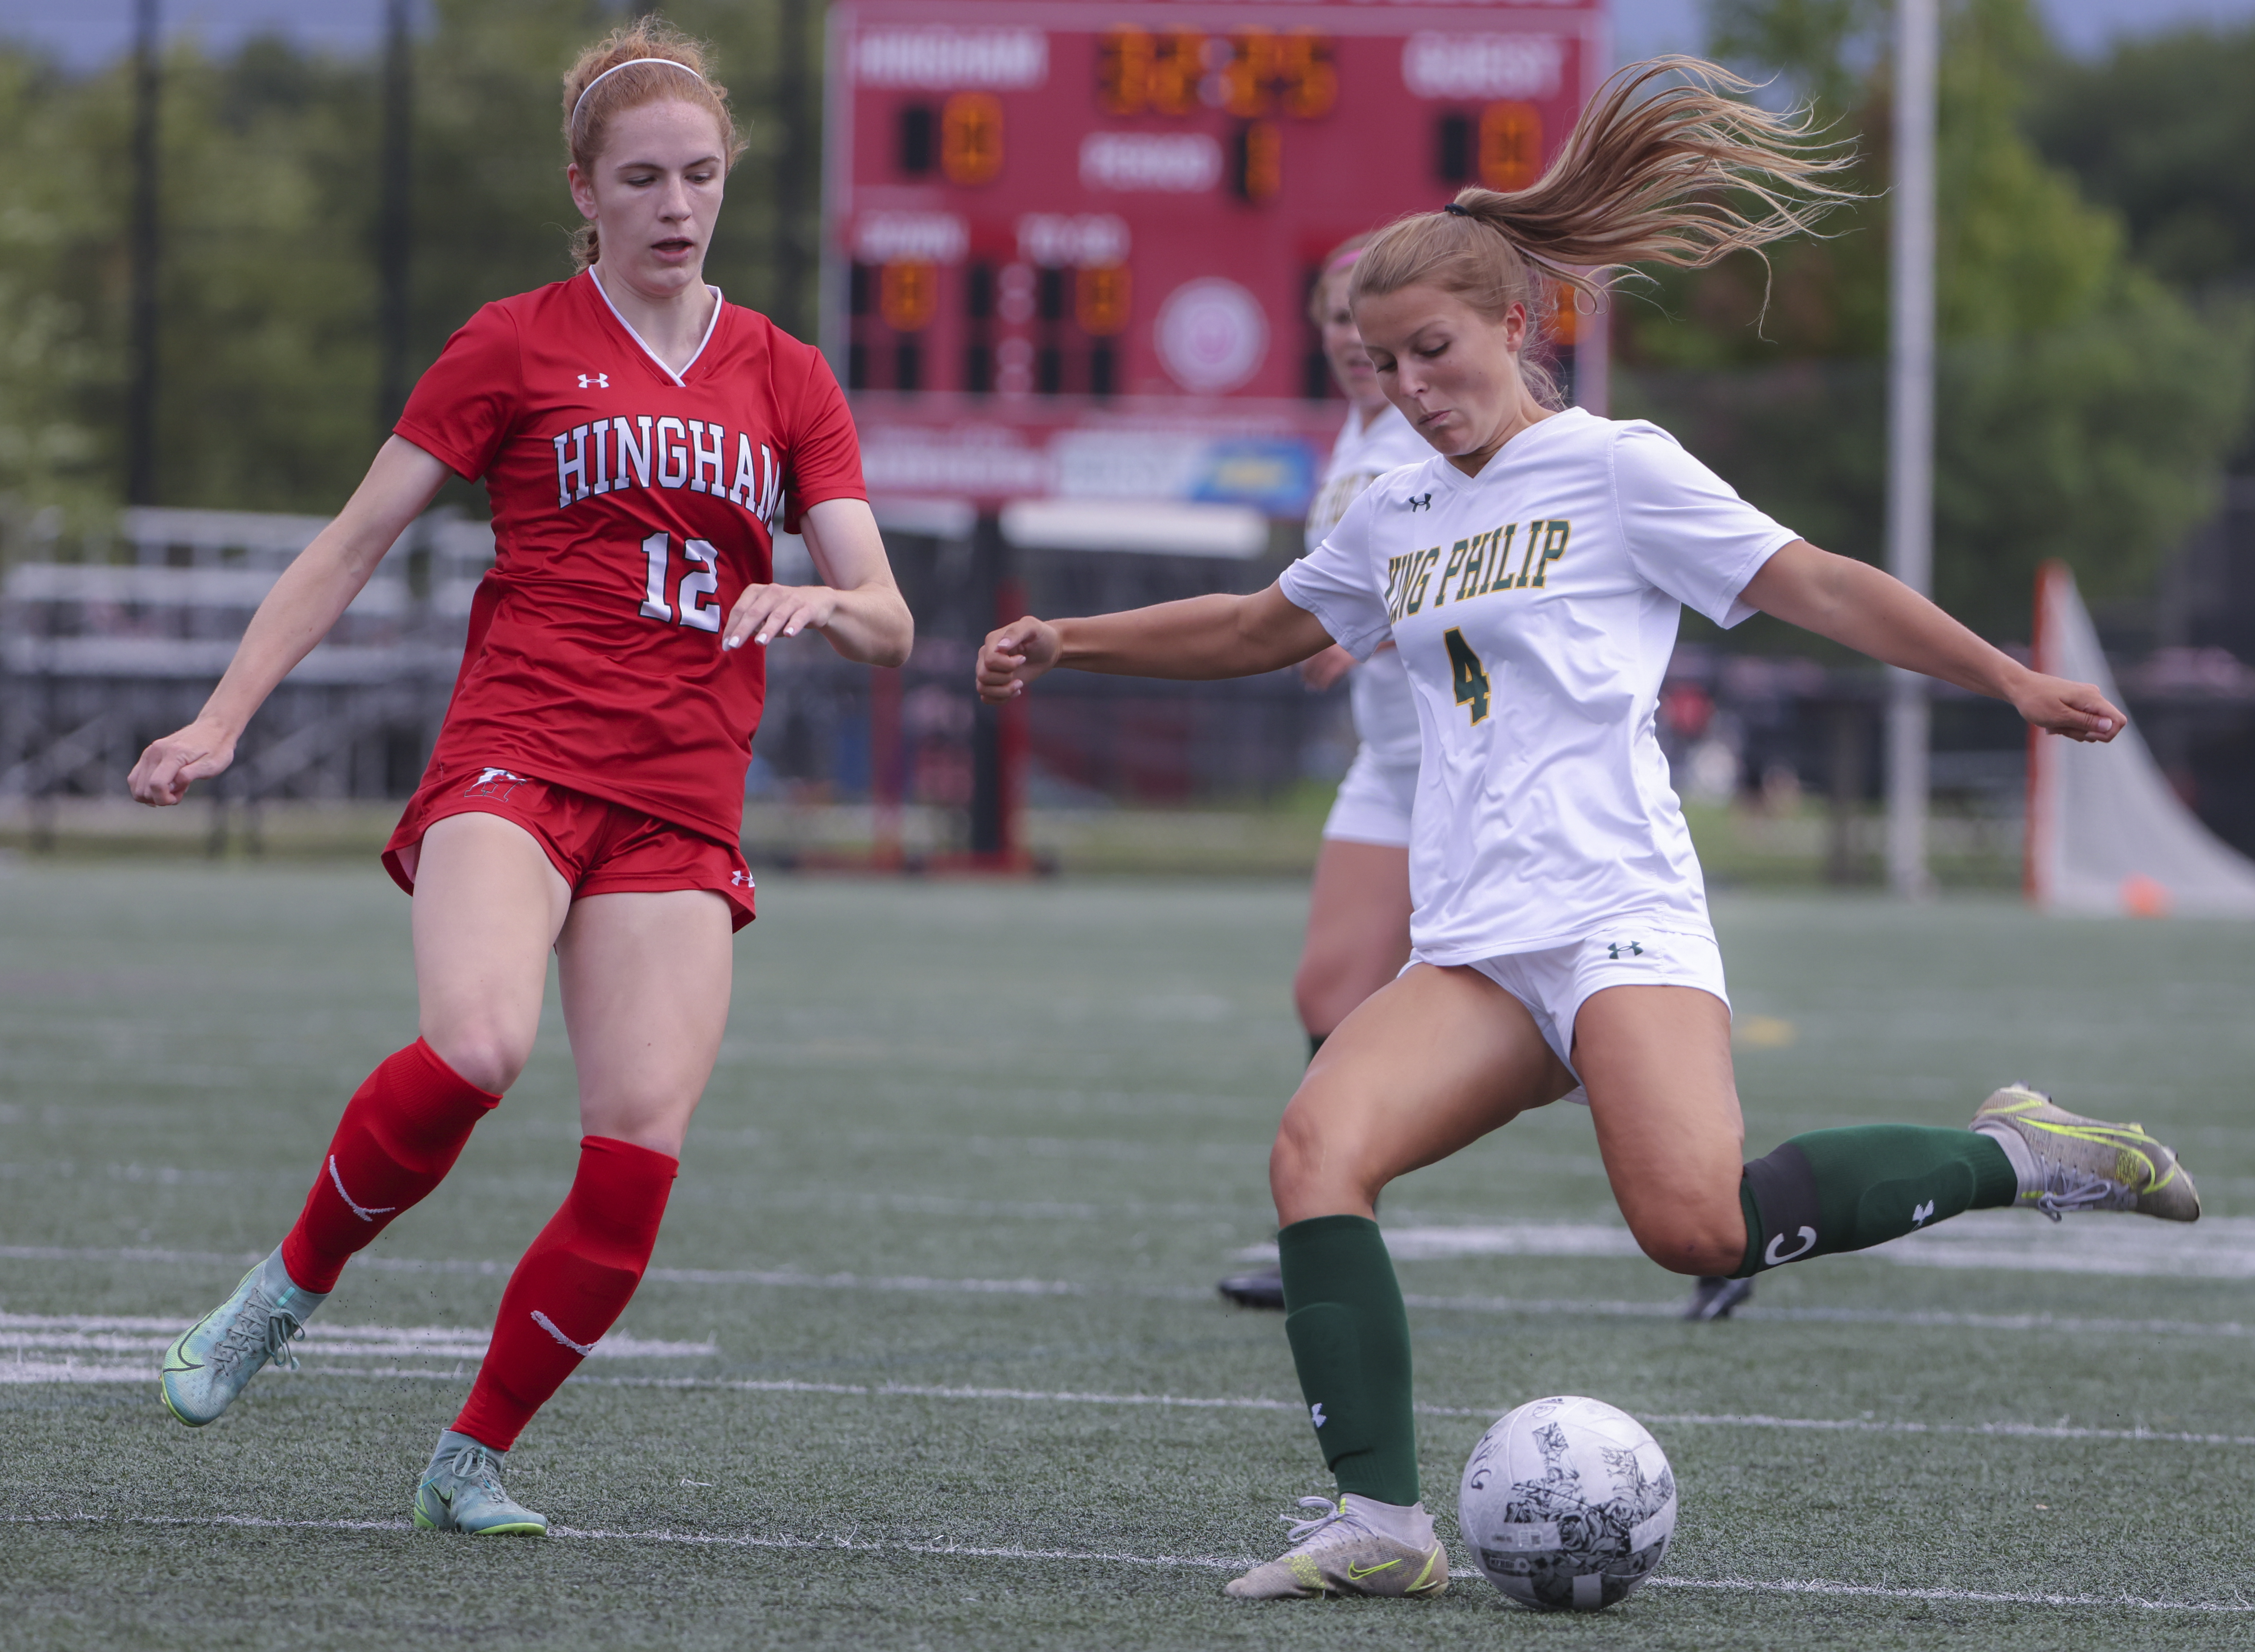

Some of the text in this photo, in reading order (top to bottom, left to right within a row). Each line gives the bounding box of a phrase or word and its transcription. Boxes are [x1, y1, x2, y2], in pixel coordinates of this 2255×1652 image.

[553, 415, 782, 537] HINGHAM
[638, 531, 720, 633] 12
[1434, 519, 1571, 608] PHILIP
[1443, 625, 1491, 727] 4
